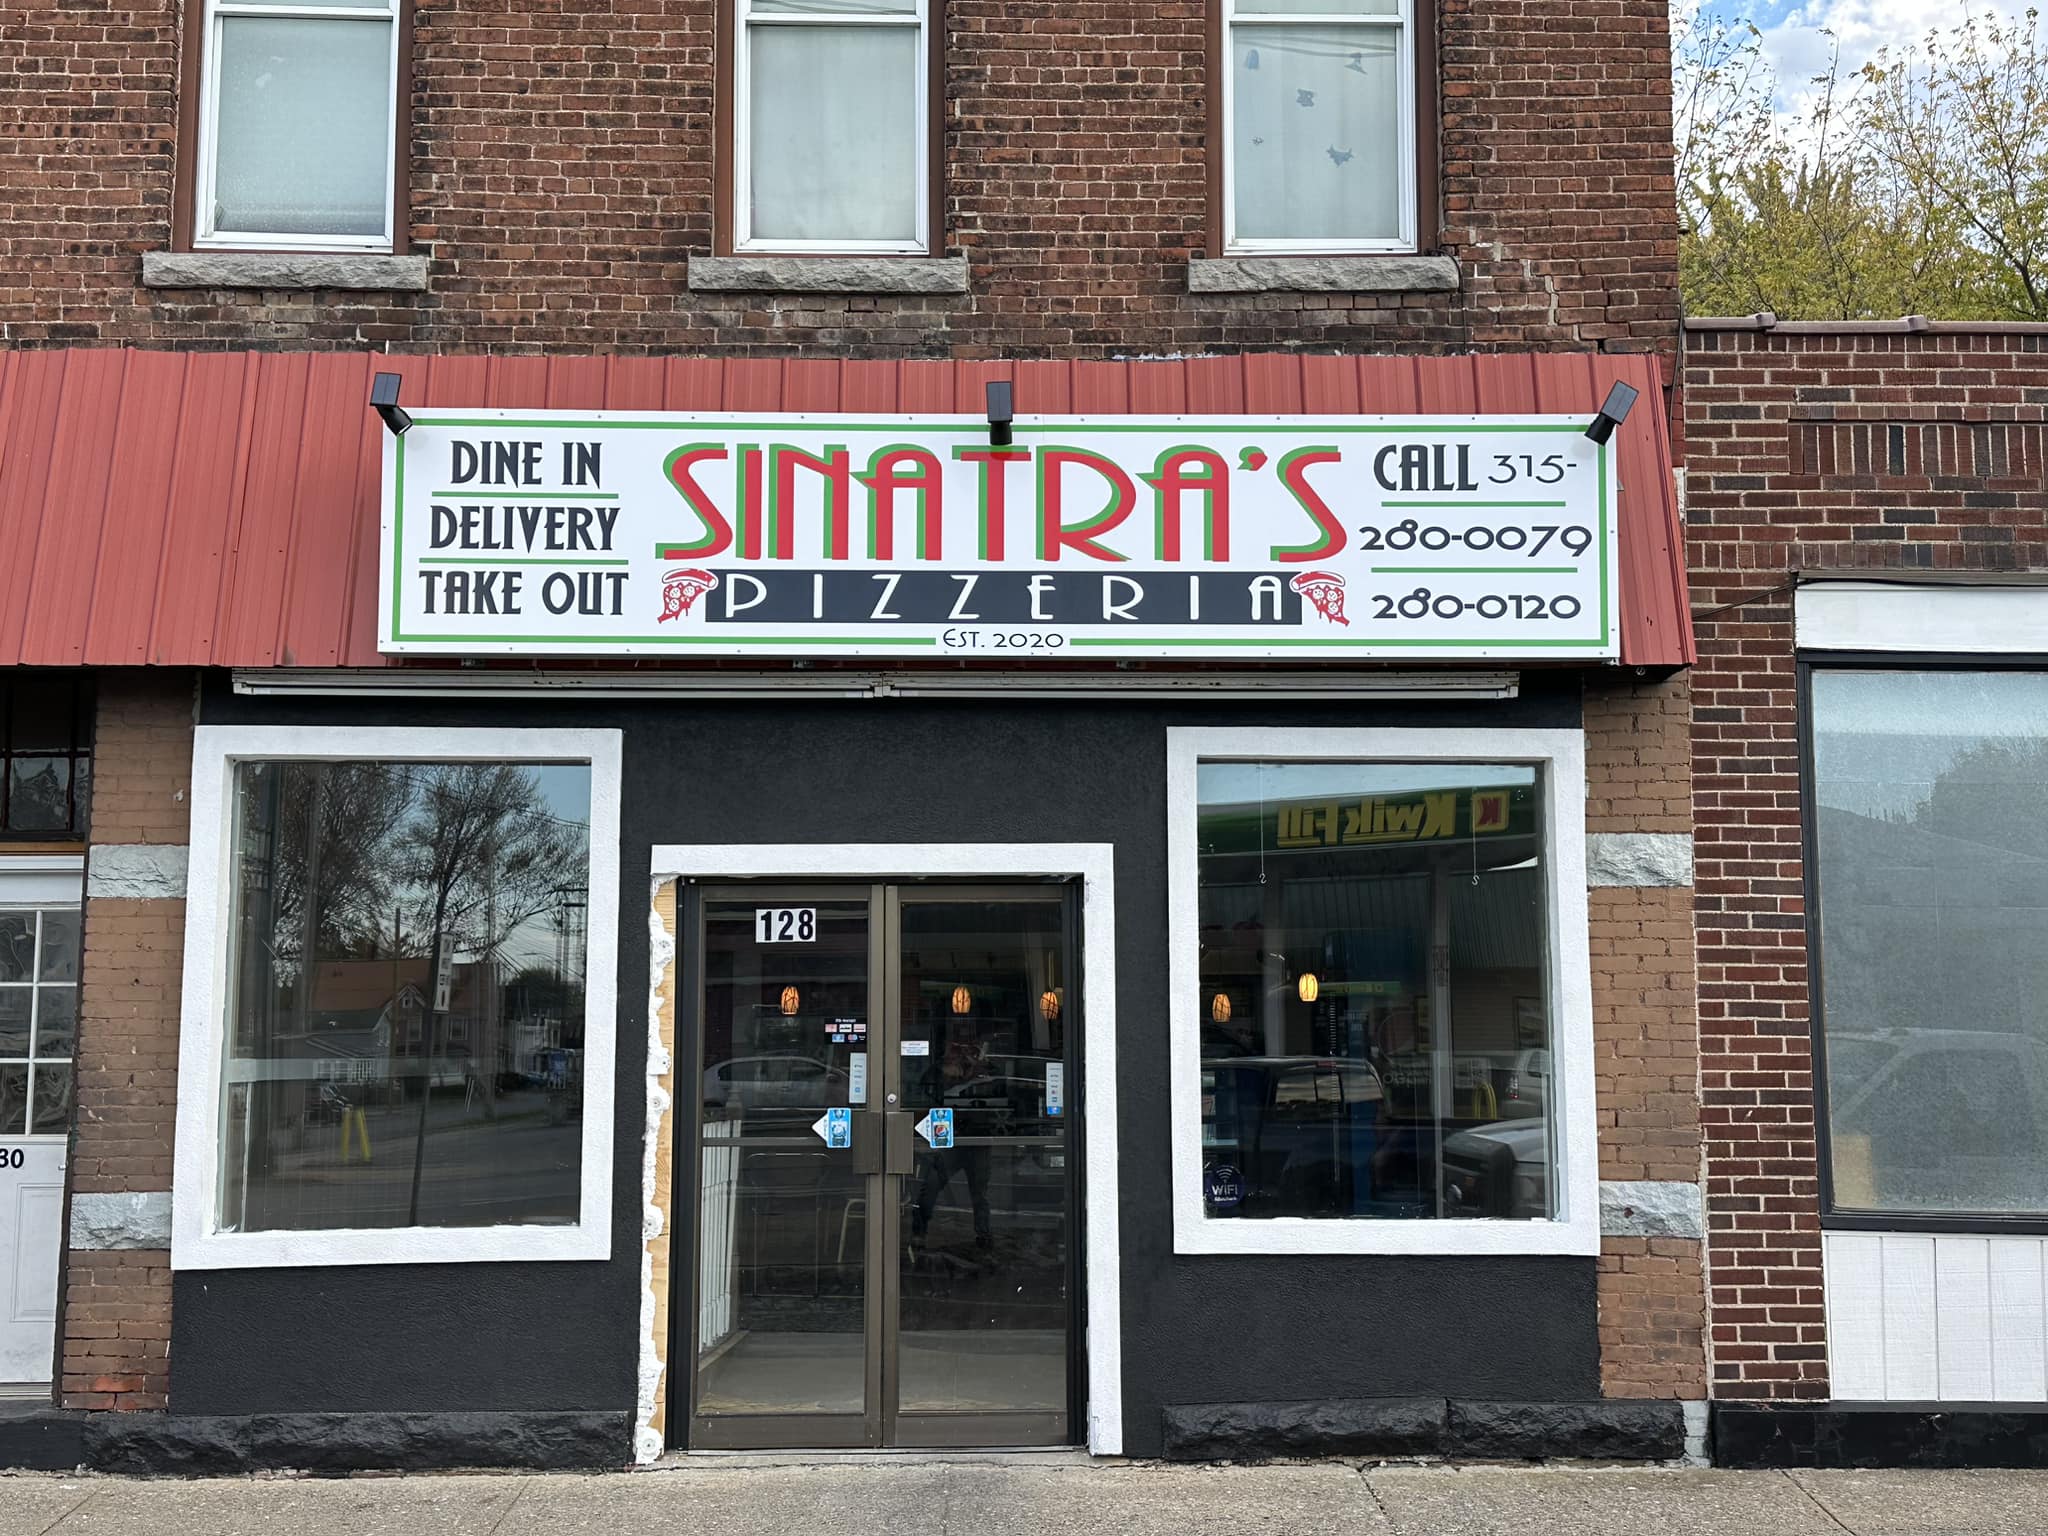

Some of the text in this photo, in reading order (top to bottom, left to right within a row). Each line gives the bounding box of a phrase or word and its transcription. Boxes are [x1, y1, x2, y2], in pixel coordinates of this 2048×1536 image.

[450, 440, 602, 489] DINE IN
[1373, 443, 1578, 492] CALL 315-
[655, 441, 1347, 563] SINATRA'S
[429, 505, 621, 554] DELIVERY
[1359, 518, 1593, 558] 280-0079
[418, 570, 630, 616] TAKE OUT
[725, 573, 1284, 621] PIZZERIA
[1371, 587, 1582, 619] 280-0120
[992, 633, 1064, 648] 2020
[758, 909, 813, 941] 128
